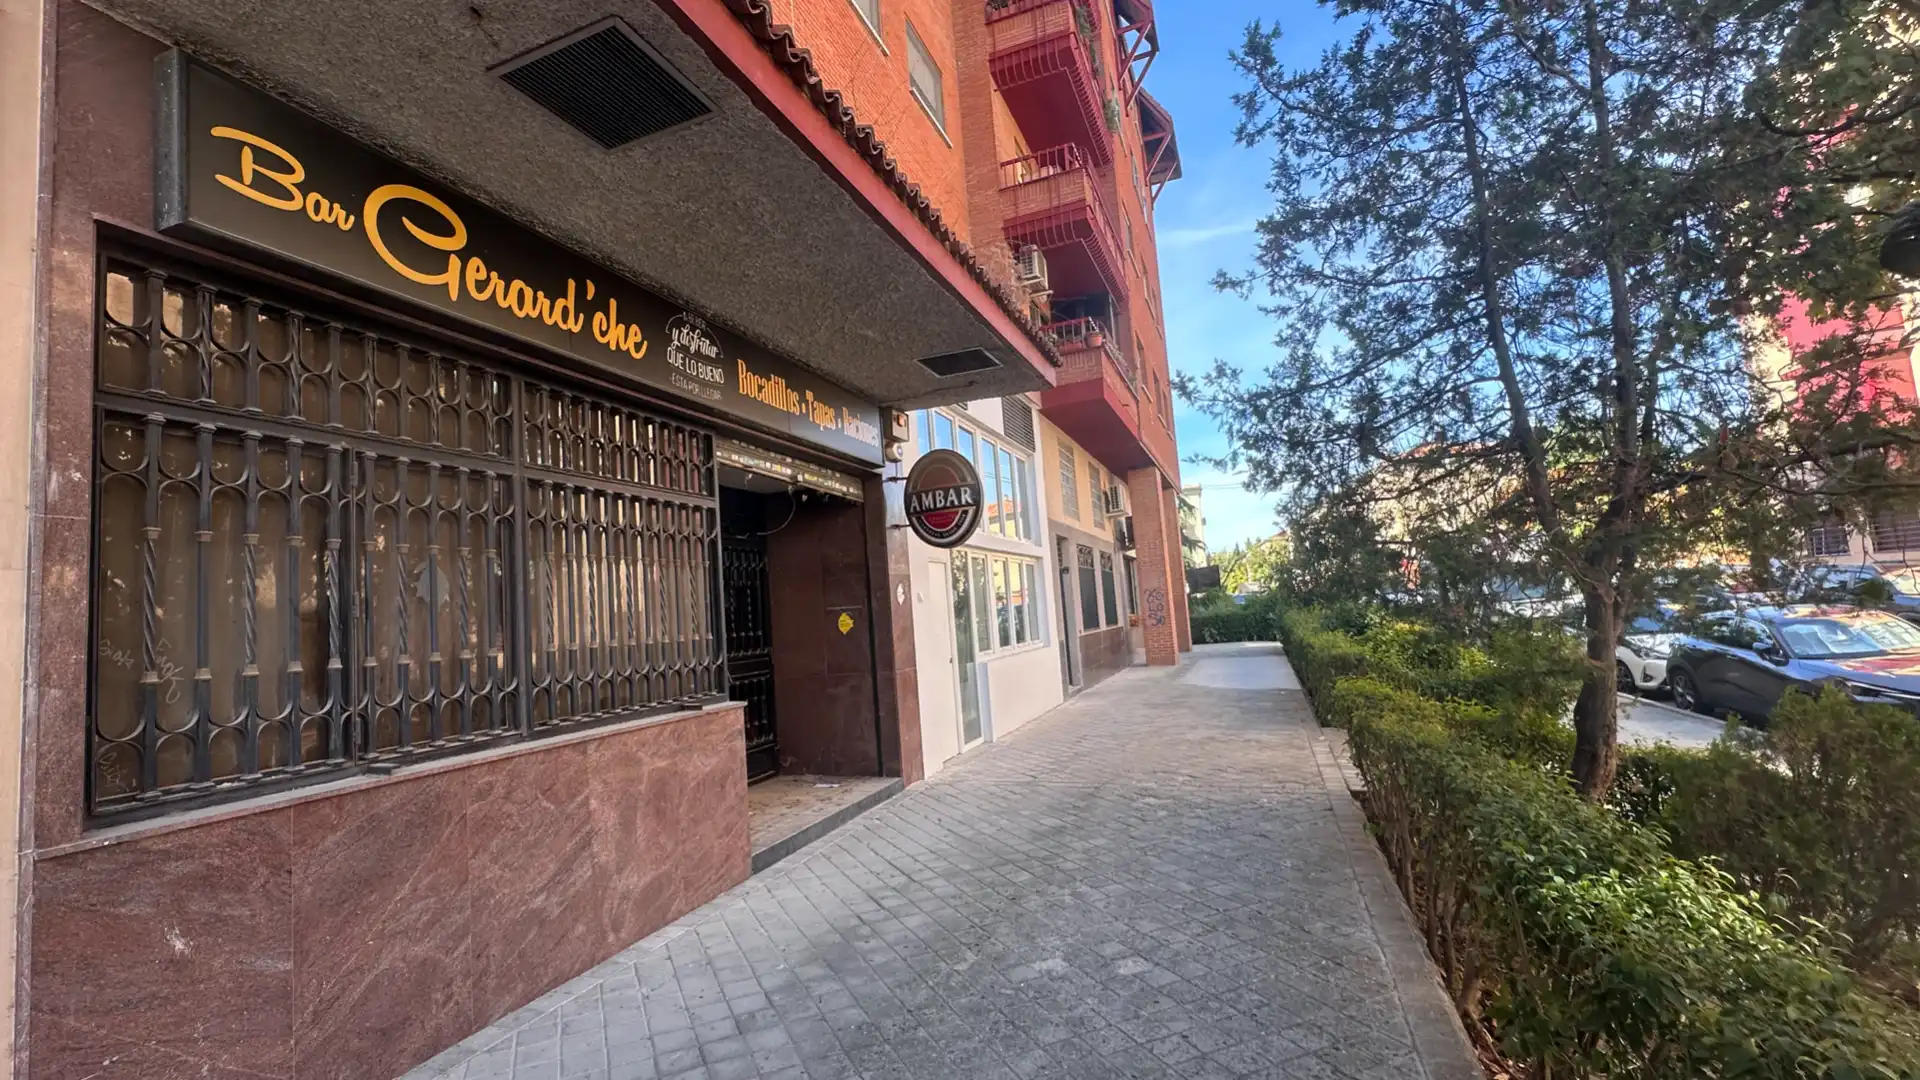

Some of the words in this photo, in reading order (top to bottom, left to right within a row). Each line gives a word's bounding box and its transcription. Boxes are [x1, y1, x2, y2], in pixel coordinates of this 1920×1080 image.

[211, 126, 355, 231] Bar
[363, 184, 648, 360] Gerard'che
[671, 327, 681, 350] y
[680, 324, 719, 358] disfrutar
[666, 346, 685, 370] QUE
[686, 357, 697, 376] LO
[698, 362, 725, 384] BUENO
[737, 358, 800, 417] Bocadillos
[805, 389, 836, 432] Tapas
[910, 487, 974, 513] AMBAR
